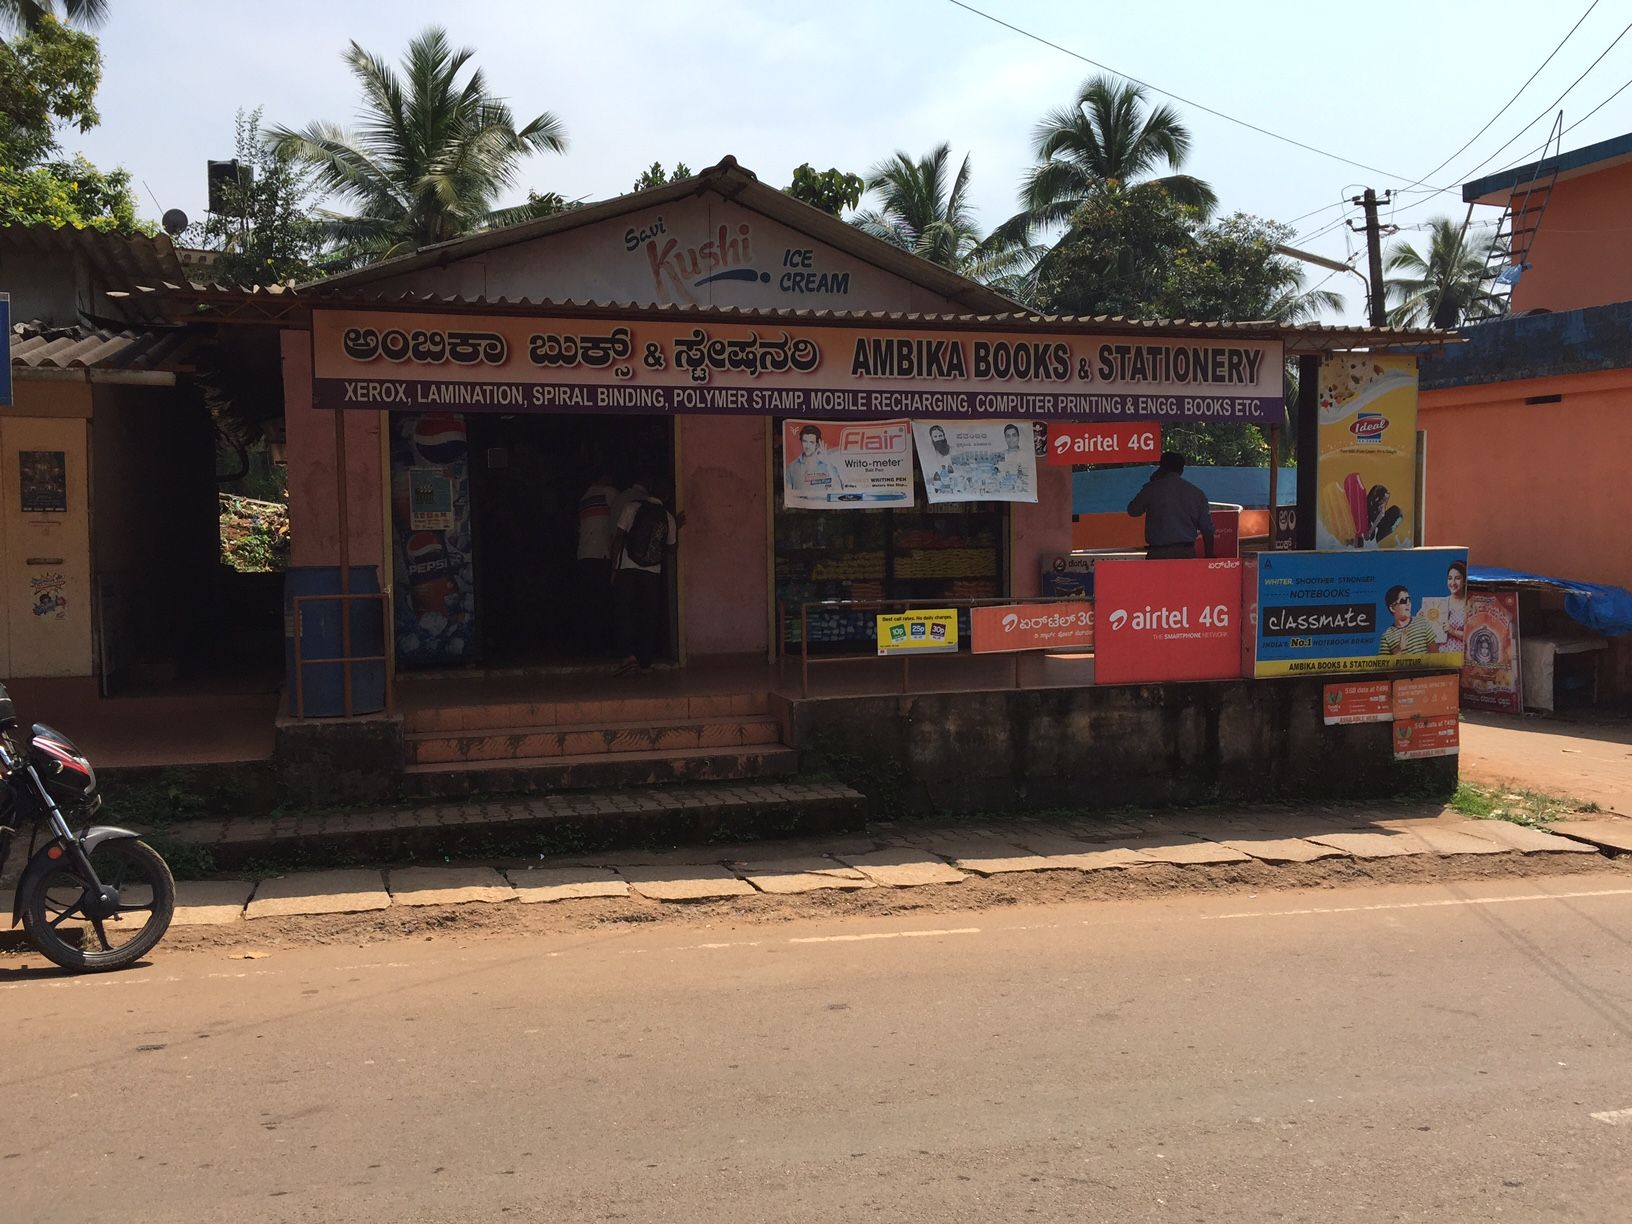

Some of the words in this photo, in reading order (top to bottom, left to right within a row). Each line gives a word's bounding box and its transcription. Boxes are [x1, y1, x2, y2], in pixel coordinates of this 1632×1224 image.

[646, 224, 752, 303] Kushi
[783, 249, 813, 268] ICE
[780, 272, 849, 294] CREAM
[343, 327, 507, 366] ಅಂಬಿಕಾ
[529, 327, 632, 379] ಬುಕ್ಸ್
[642, 341, 665, 368] &
[673, 328, 818, 384] ಸ್ಟೇಷನರಿ
[850, 336, 967, 380] AMBIKA
[973, 341, 1072, 383] BOOKS
[1077, 357, 1091, 382] &
[1097, 345, 1264, 386] STATIONERY
[344, 382, 412, 405] XEROX,
[416, 385, 526, 407] LAMINATION,
[532, 388, 593, 405] SPIRAL
[597, 388, 667, 410] BINDING,
[673, 390, 748, 408] POLYMER
[752, 391, 805, 411] STAMP,
[809, 392, 867, 410] MOBILE
[871, 394, 971, 414] RECHARGING,
[976, 395, 1054, 412] COMPUTER
[1058, 397, 1121, 413] PRINTING
[1125, 397, 1134, 412] &
[1138, 397, 1180, 414] ENGG.
[1184, 399, 1231, 415] BOOKS
[1235, 400, 1264, 416] ETC.
[1356, 419, 1385, 432] Ideal
[843, 430, 902, 450] Flair
[1074, 434, 1119, 453] airtel
[1128, 434, 1153, 452] 4G
[409, 560, 447, 574] PEPSI
[1290, 589, 1351, 599] NOTEBOOKS
[1131, 606, 1189, 631] airtel
[1199, 605, 1229, 628] 4G
[1349, 660, 1389, 668] STATIONERY
